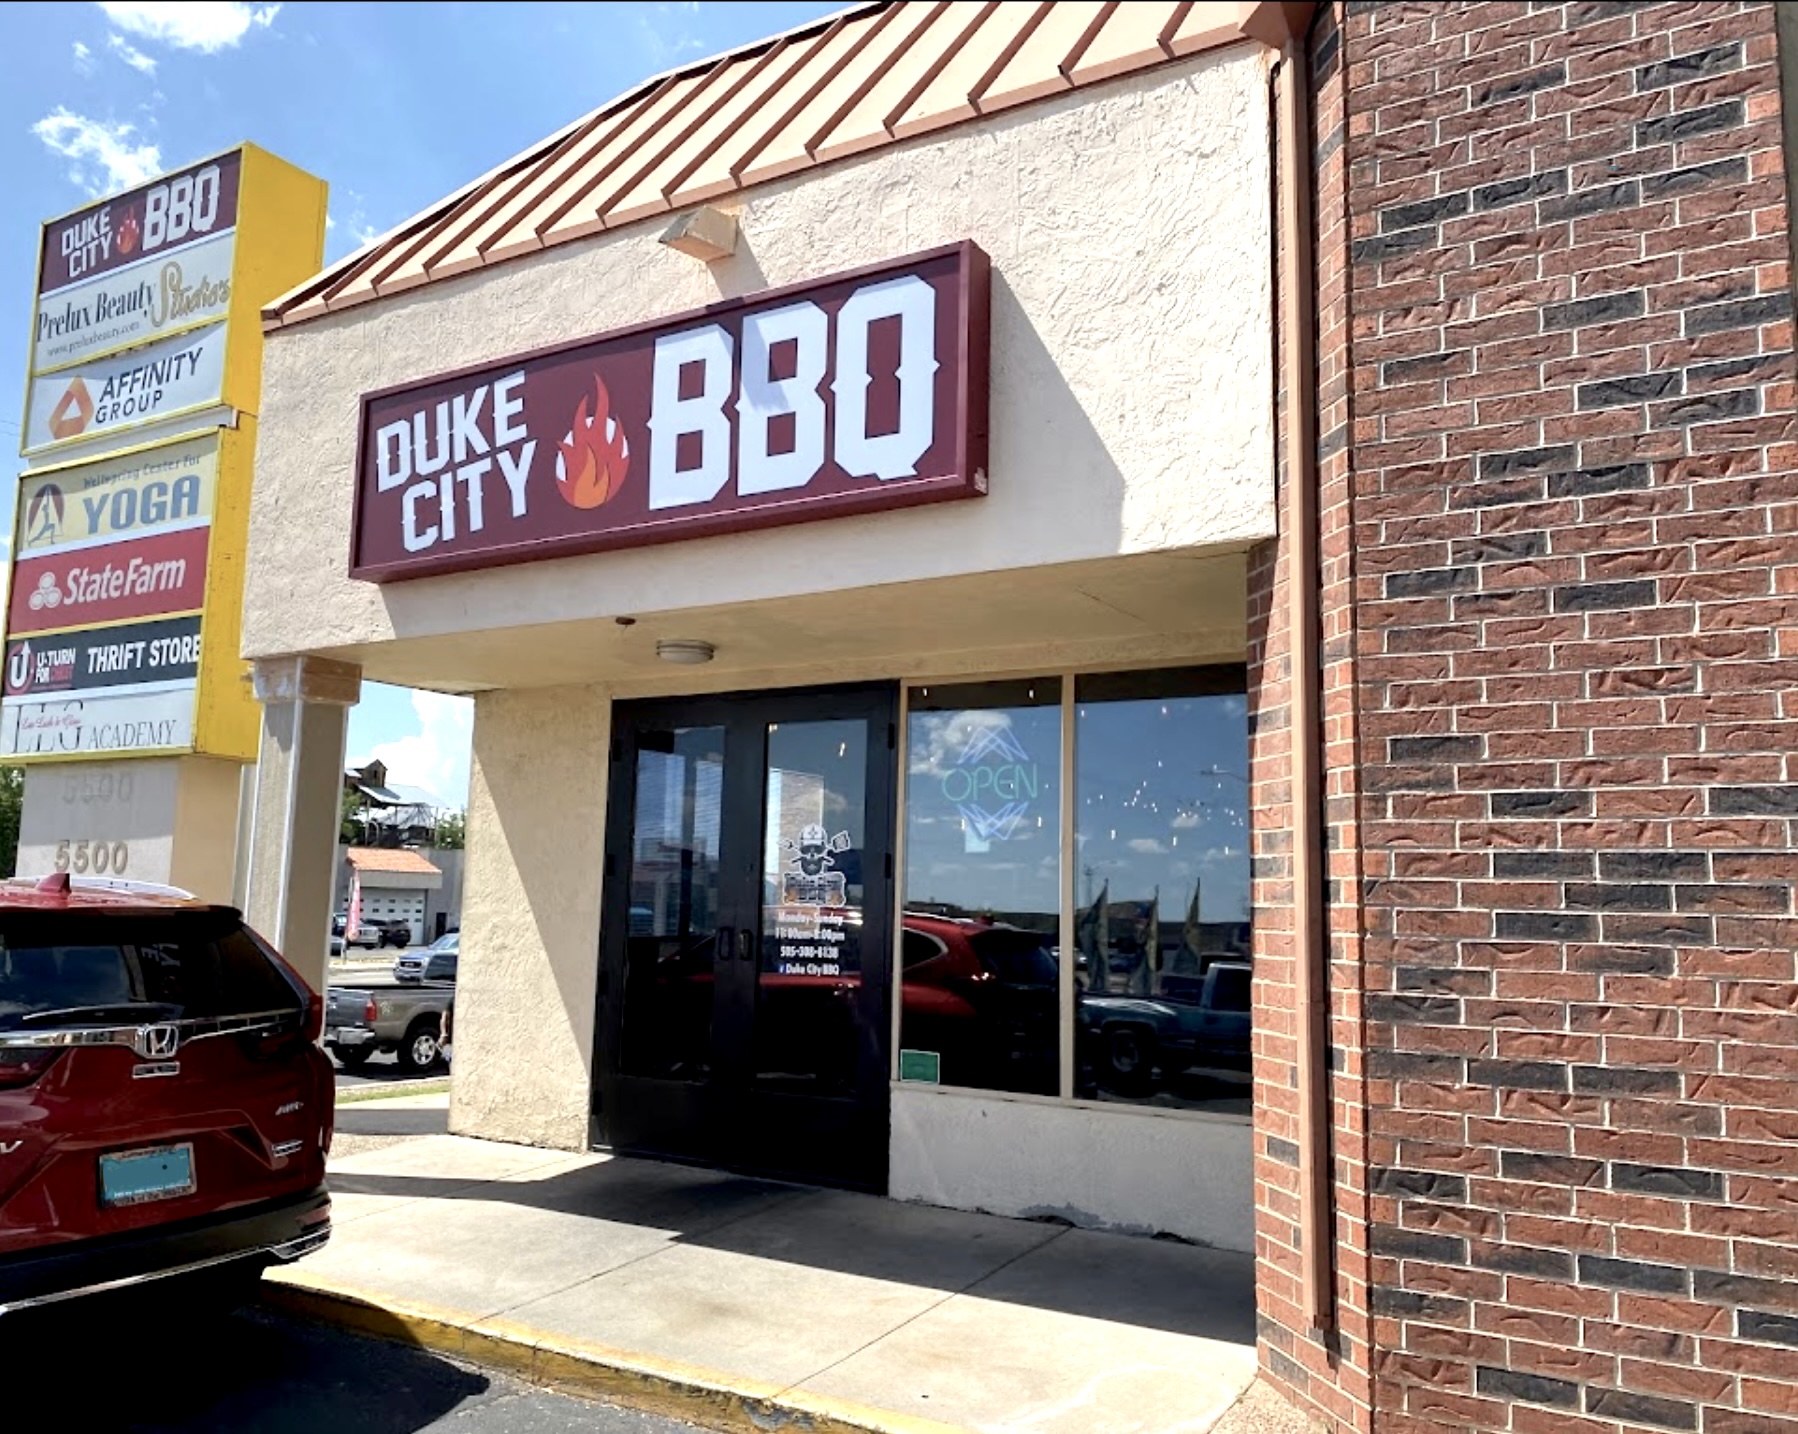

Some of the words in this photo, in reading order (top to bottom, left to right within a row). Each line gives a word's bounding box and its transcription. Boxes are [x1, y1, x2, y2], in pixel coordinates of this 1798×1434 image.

[61, 205, 111, 257] DUKE
[142, 164, 220, 251] BBQ
[68, 231, 113, 278] CITY
[37, 301, 91, 342] Prelux
[95, 281, 157, 324] Beauty
[151, 261, 231, 327] Studios
[99, 347, 203, 403] AFFINITY
[647, 273, 941, 511] BBQ
[95, 389, 163, 424] GROUP
[376, 369, 526, 493] DUKE
[83, 474, 201, 535] YOGA
[402, 439, 538, 553] CITY
[37, 647, 76, 668] U-TURN
[87, 641, 147, 674] THRIFT
[149, 633, 201, 668] STORE
[87, 719, 177, 750] ACADEMY
[941, 763, 1038, 801] OPEN
[54, 838, 129, 876] 5500
